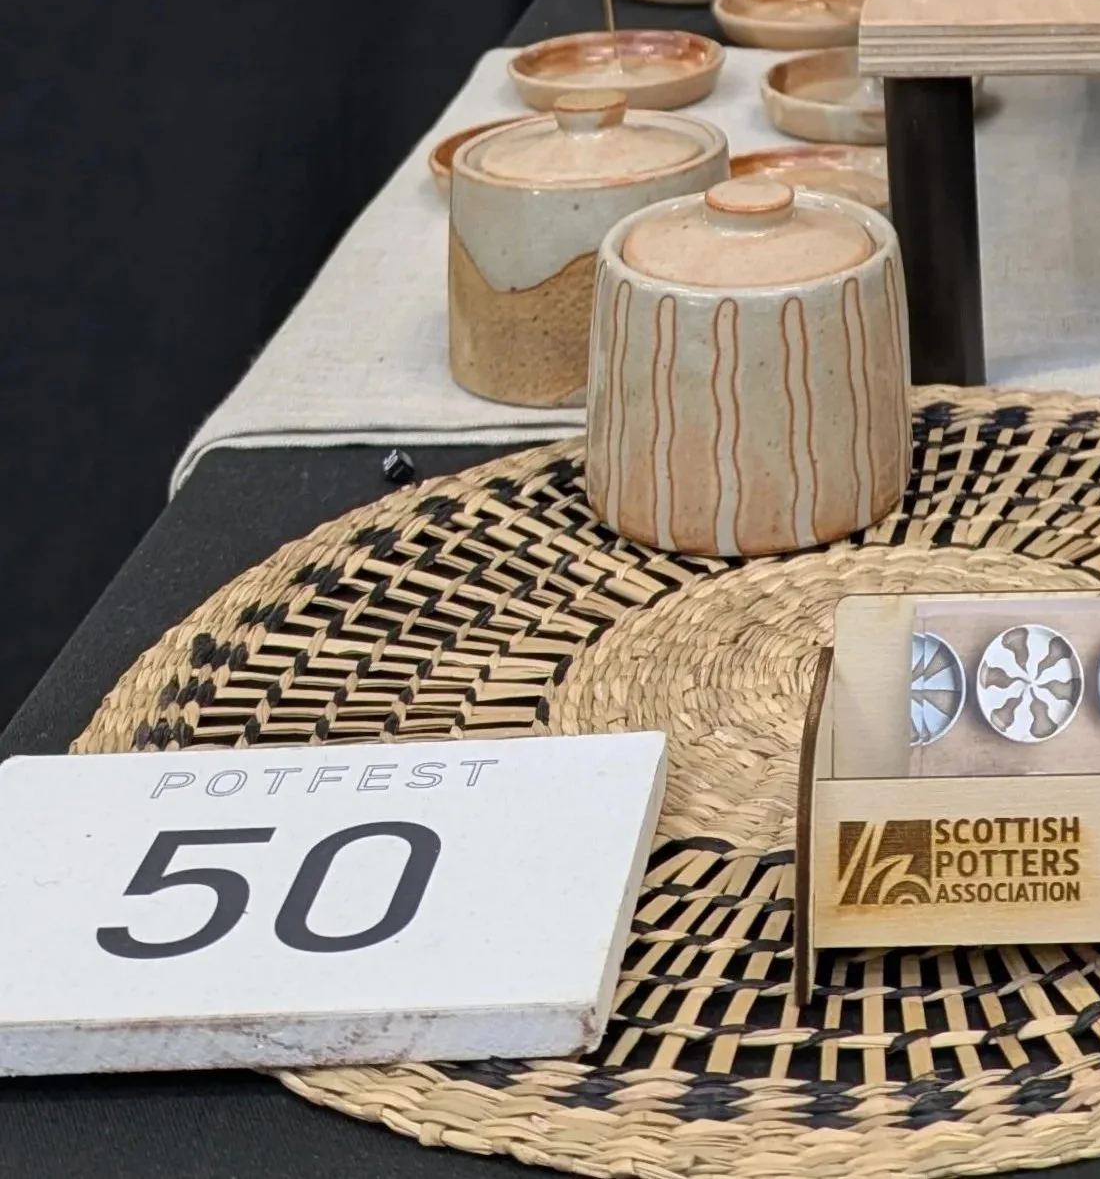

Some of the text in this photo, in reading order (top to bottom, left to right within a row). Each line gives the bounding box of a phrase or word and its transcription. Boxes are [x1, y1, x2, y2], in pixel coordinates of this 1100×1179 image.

[150, 759, 498, 799] POTFEST
[935, 816, 1080, 844] SCOTTISH
[936, 848, 1080, 877] POTTERS
[96, 821, 441, 959] 50
[935, 881, 1081, 903] ASSOCIATION
